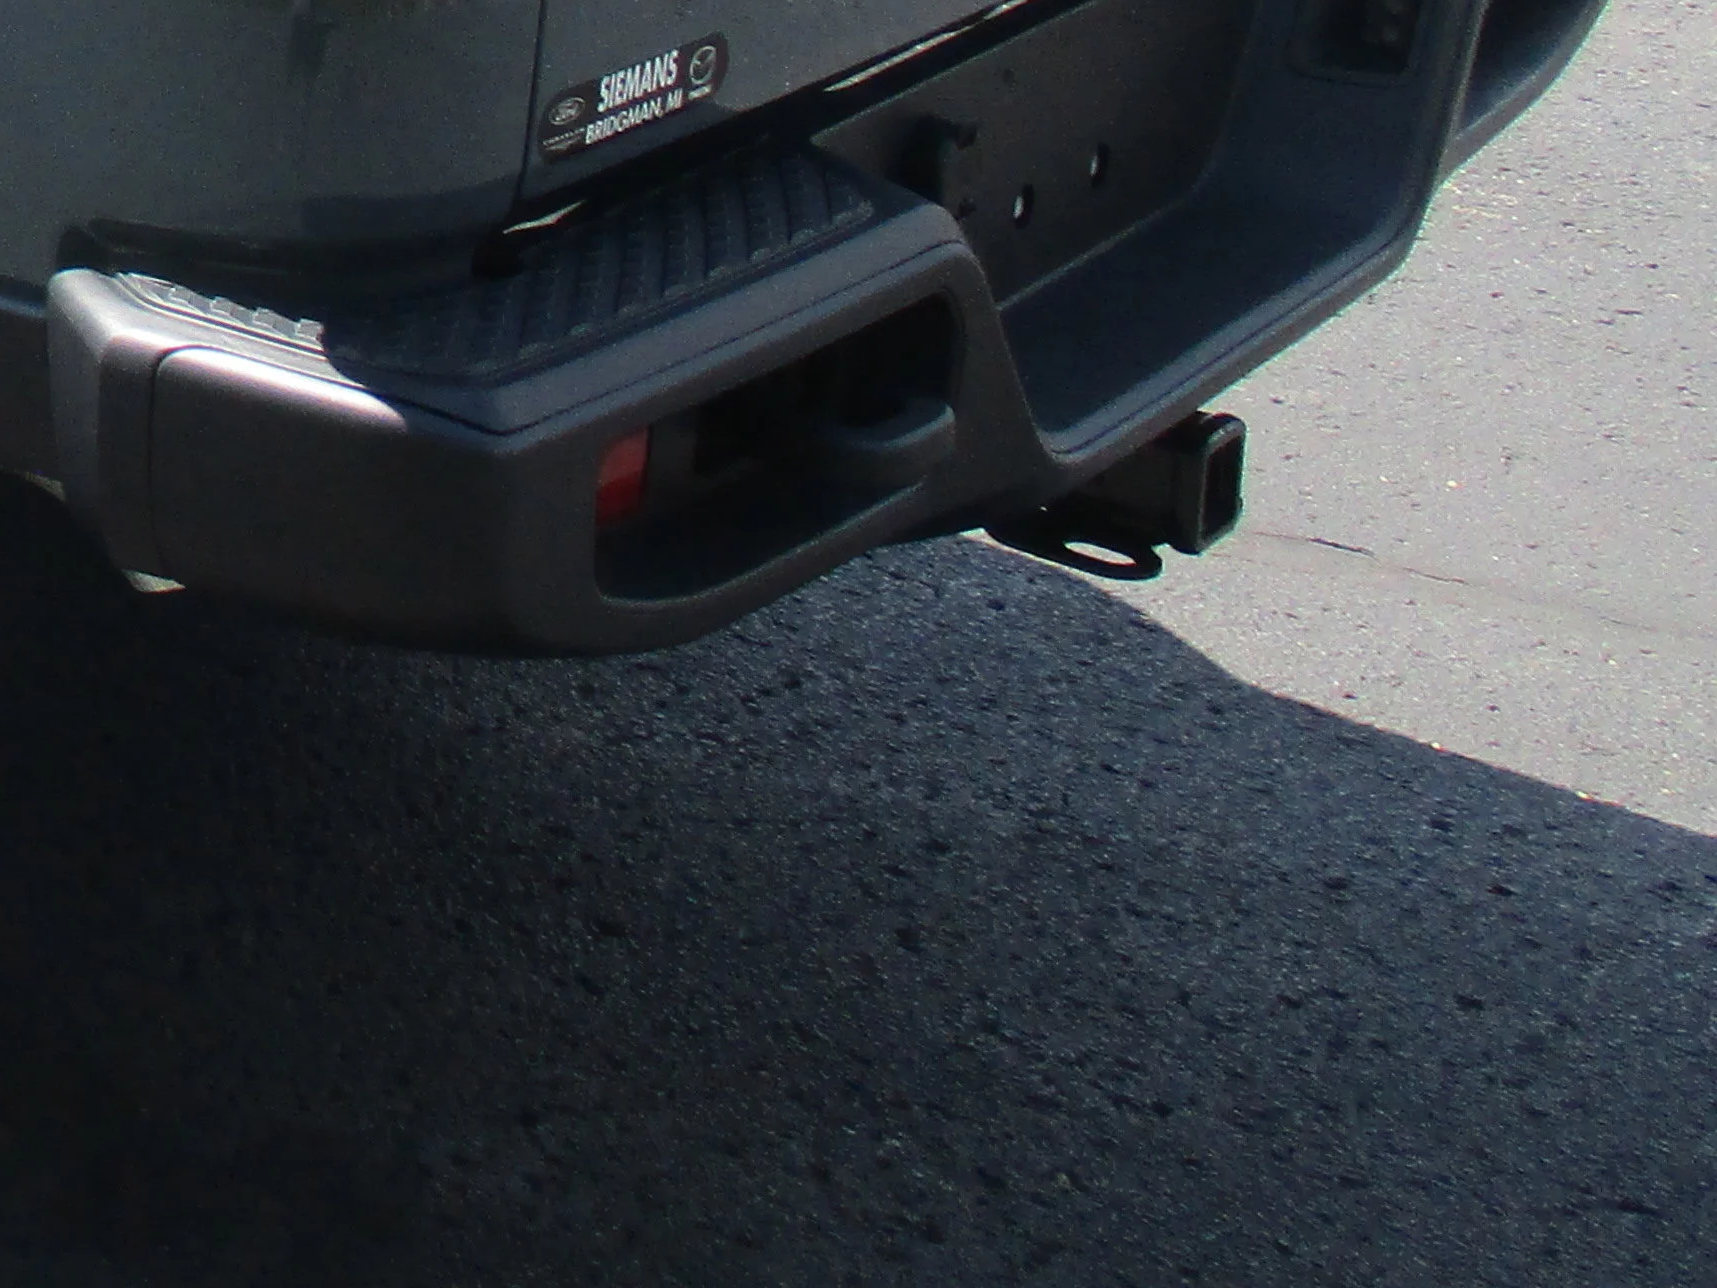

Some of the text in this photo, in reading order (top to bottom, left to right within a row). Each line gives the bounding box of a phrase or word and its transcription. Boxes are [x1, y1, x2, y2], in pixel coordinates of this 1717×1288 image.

[597, 49, 680, 112] SIEMANS
[585, 96, 664, 145] BRIDGMAN,
[666, 88, 684, 113] MI
